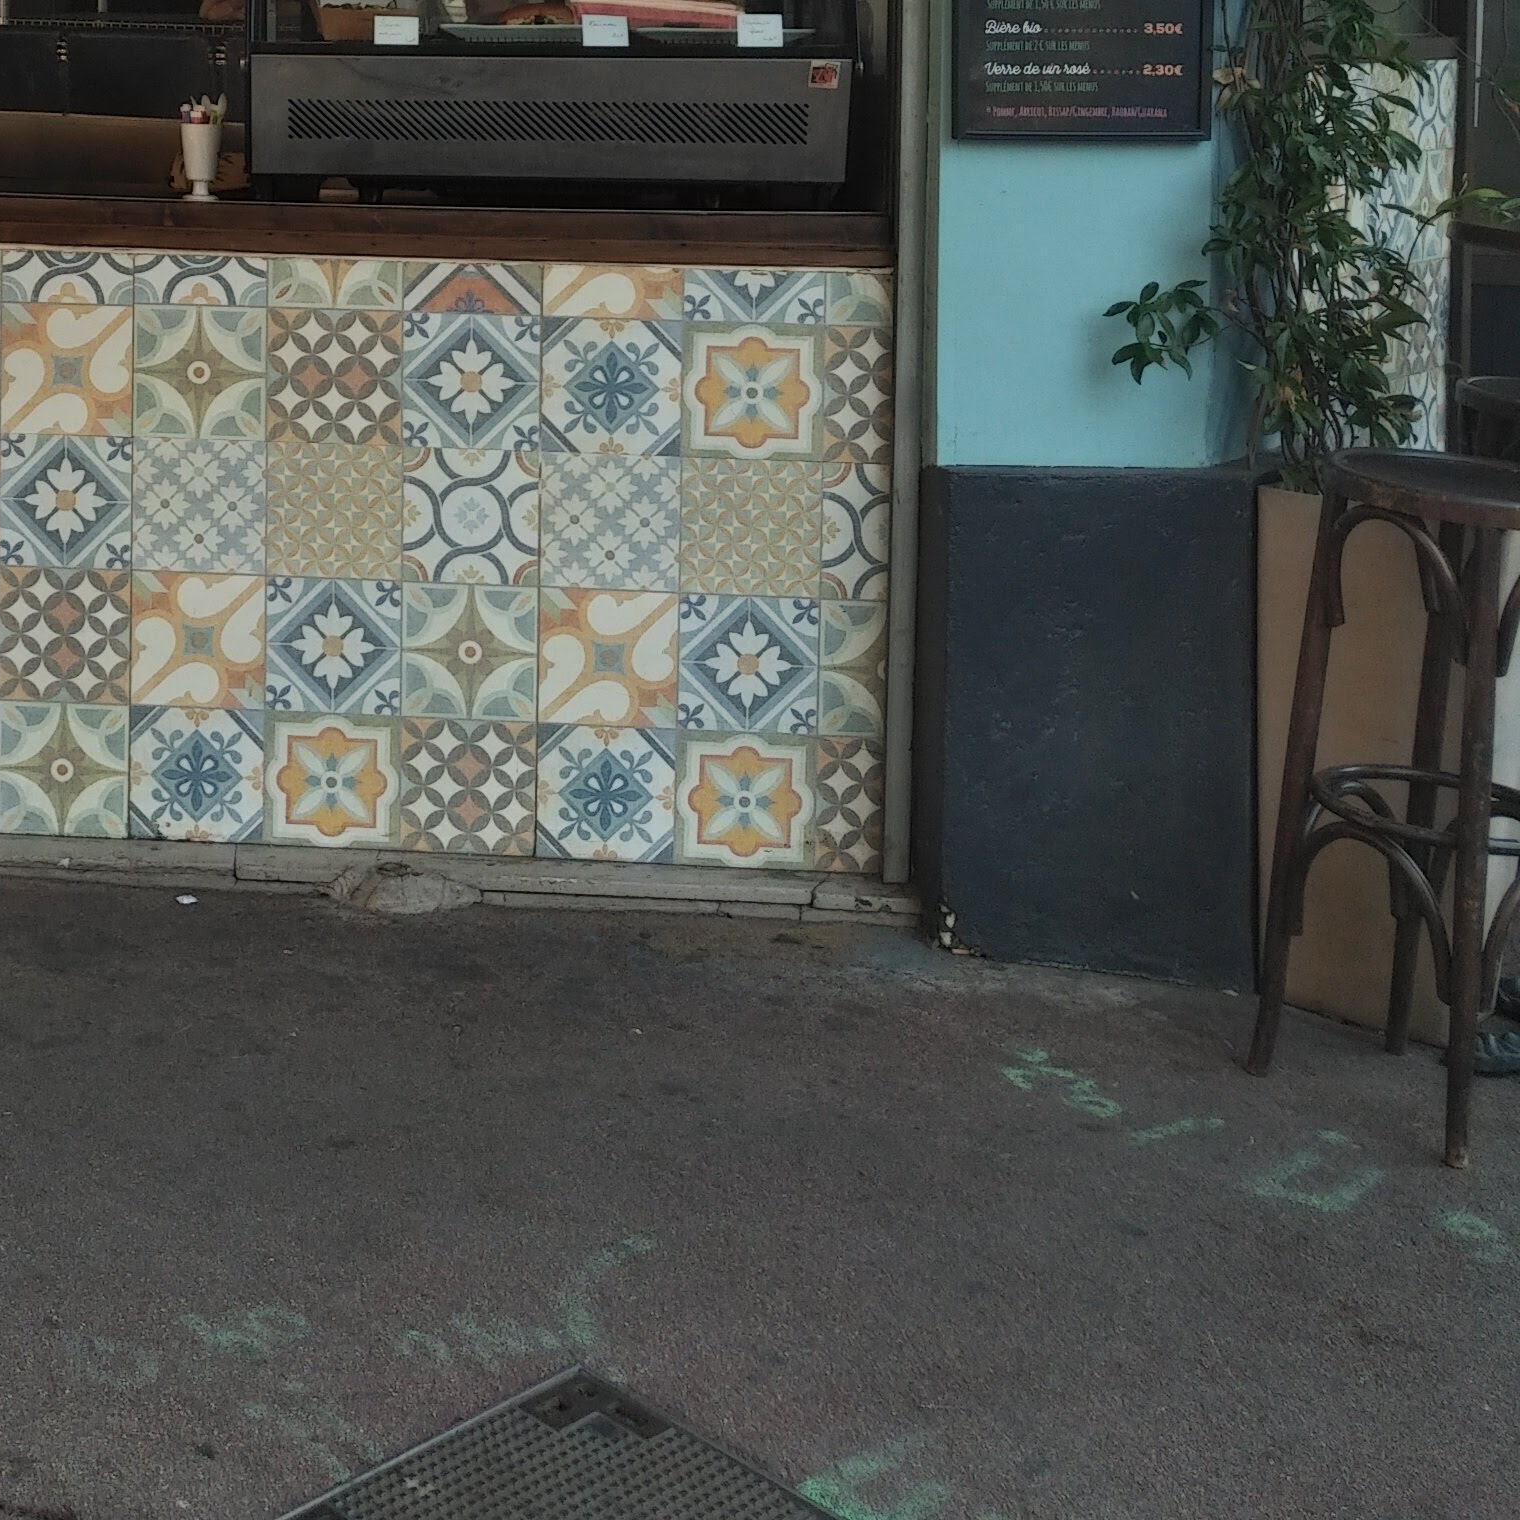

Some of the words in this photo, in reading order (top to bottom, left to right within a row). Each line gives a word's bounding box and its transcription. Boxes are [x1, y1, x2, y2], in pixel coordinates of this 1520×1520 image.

[985, 20, 1021, 34] Bière
[1022, 20, 1042, 34] bio
[1143, 23, 1183, 34] 3,50€
[984, 62, 1021, 75] Verre
[1023, 62, 1040, 75] de
[1042, 63, 1061, 75] vin
[1063, 62, 1091, 75] rosé
[1142, 64, 1183, 76] 2,30€
